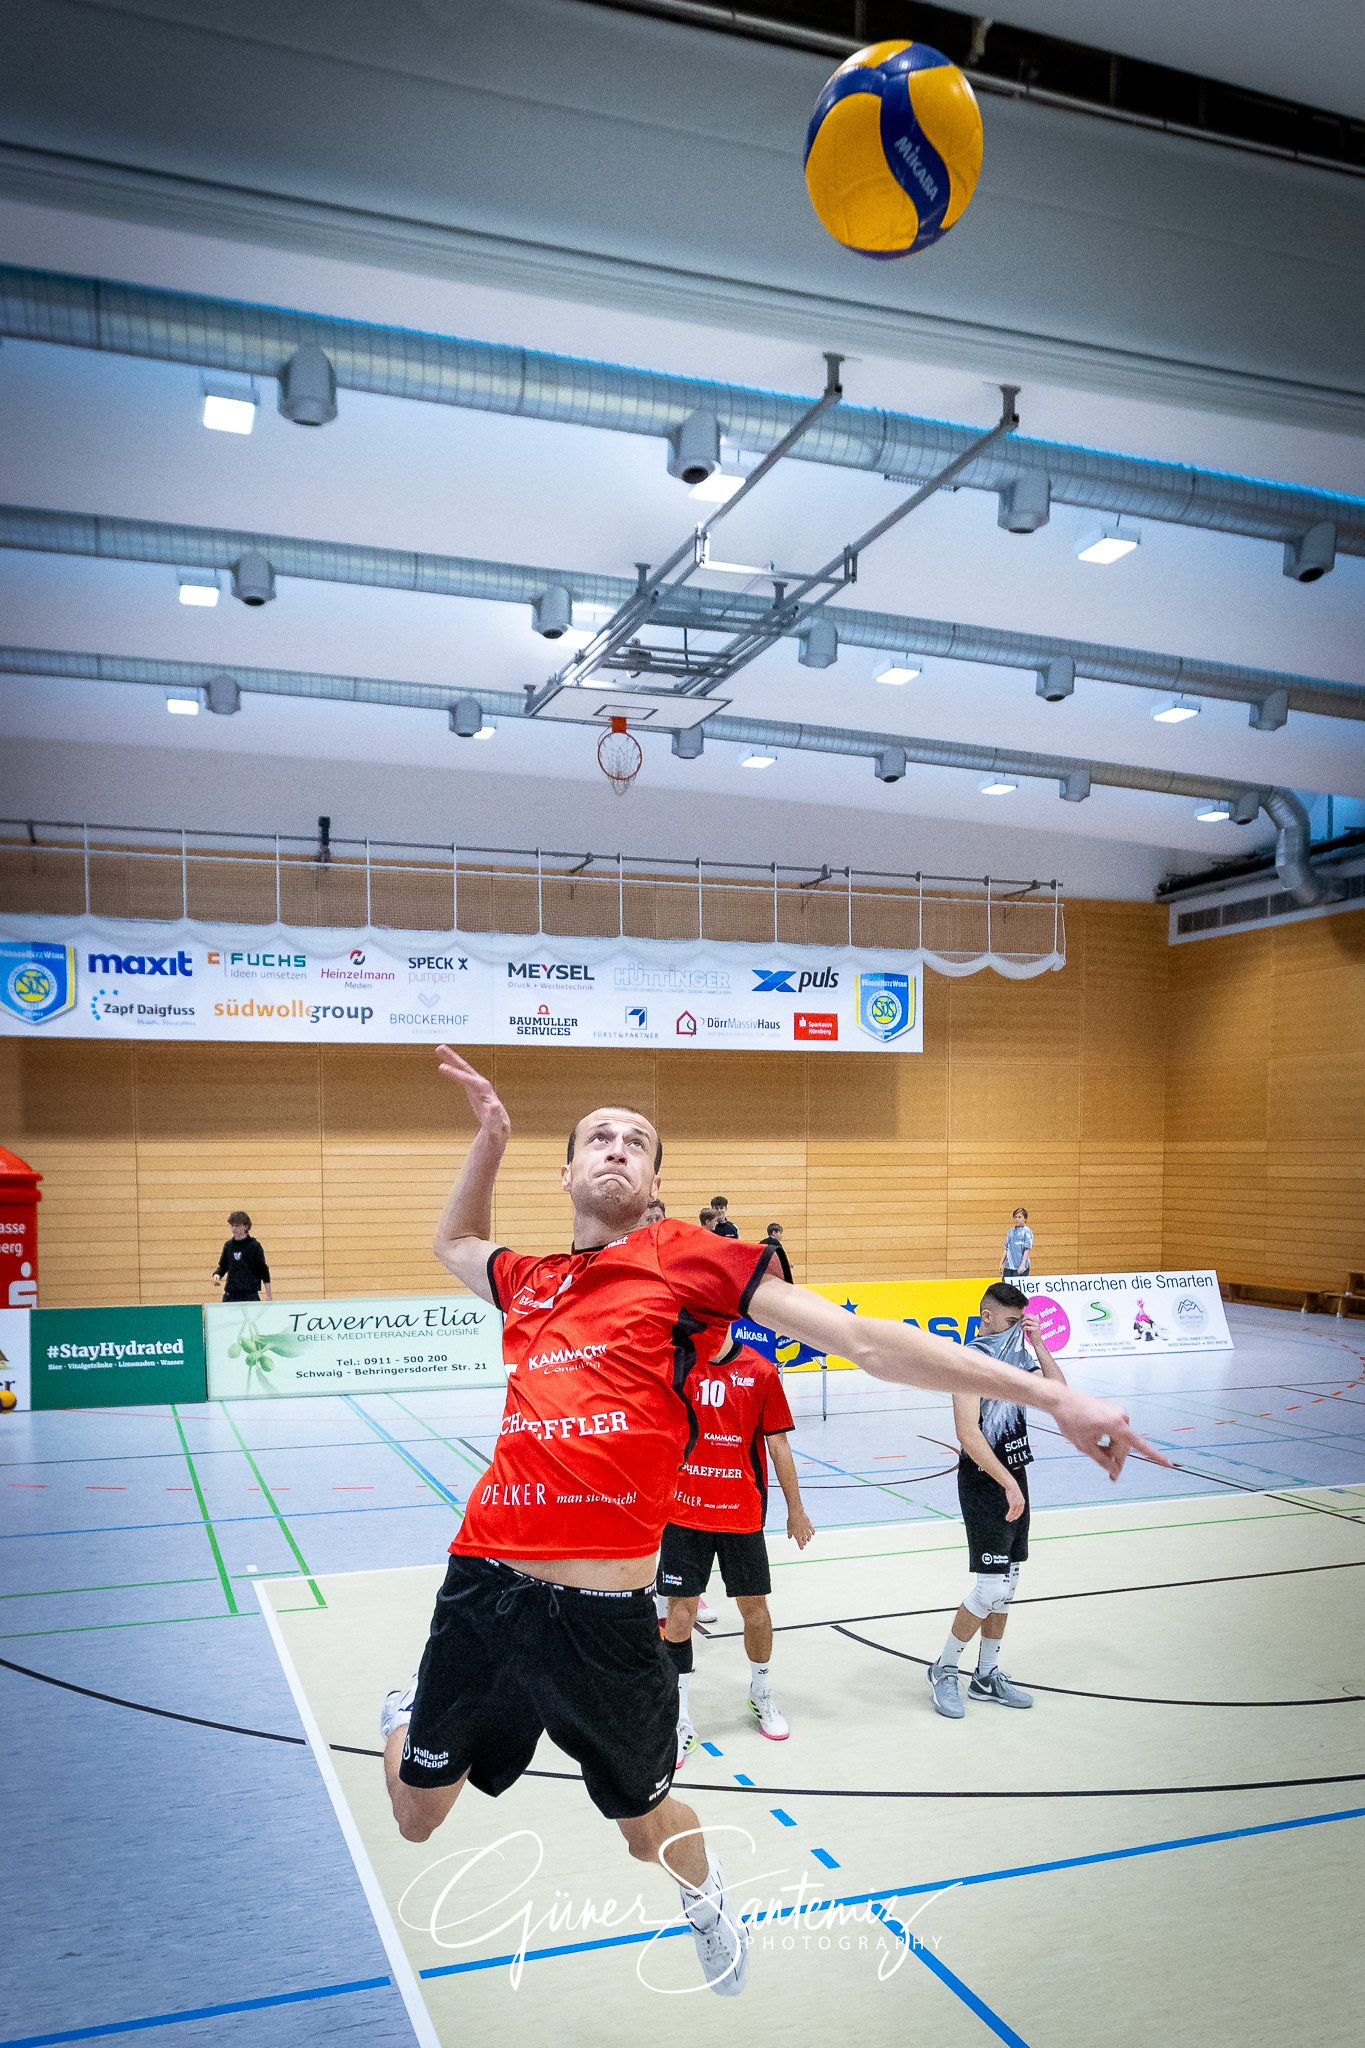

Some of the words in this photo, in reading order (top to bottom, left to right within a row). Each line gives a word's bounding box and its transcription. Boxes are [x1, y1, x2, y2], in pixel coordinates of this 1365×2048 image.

[88, 951, 192, 977] maxit
[231, 953, 306, 968] FUCHS
[408, 957, 454, 970] SPECK
[230, 970, 257, 979] Ideen
[260, 971, 307, 979] umsetzen
[321, 969, 395, 981] Heinzelmann
[409, 972, 455, 984] pumpen
[507, 962, 595, 981] MEYSEL
[344, 981, 372, 990] Medien
[508, 981, 530, 989] Druck
[541, 982, 594, 991] Werbetechnik
[798, 966, 840, 993] puls
[103, 1003, 134, 1016] Zapf
[137, 1004, 195, 1017] Daigfuss
[516, 1026, 571, 1036] SERVICES
[707, 1018, 781, 1030] DörrMassivHaus
[808, 1021, 833, 1029] Sparkasse
[1010, 1279, 1040, 1294] Hier
[1045, 1276, 1129, 1293] schnarchen
[1131, 1275, 1152, 1290] die
[1156, 1274, 1214, 1289] Smarten
[288, 1311, 420, 1332] Taverna
[423, 1306, 487, 1327] Elia
[297, 1333, 334, 1342] GREEK
[337, 1330, 433, 1341] MEDITERRANEAN
[437, 1327, 480, 1336] CUISINE
[47, 1339, 184, 1361] #StayHydrated
[118, 1360, 155, 1368] Limonaden
[336, 1359, 361, 1367] Tel.:
[364, 1357, 391, 1366] 0911
[403, 1355, 425, 1364] 500
[428, 1354, 448, 1362] 200
[295, 1370, 342, 1379] Schwaig
[354, 1364, 448, 1376] Behringersdorfer
[451, 1363, 471, 1371] Str.
[699, 1379, 726, 1407] 10
[481, 1482, 546, 1505] DELKER
[556, 1494, 582, 1504] man
[413, 1746, 449, 1760] Hallasch
